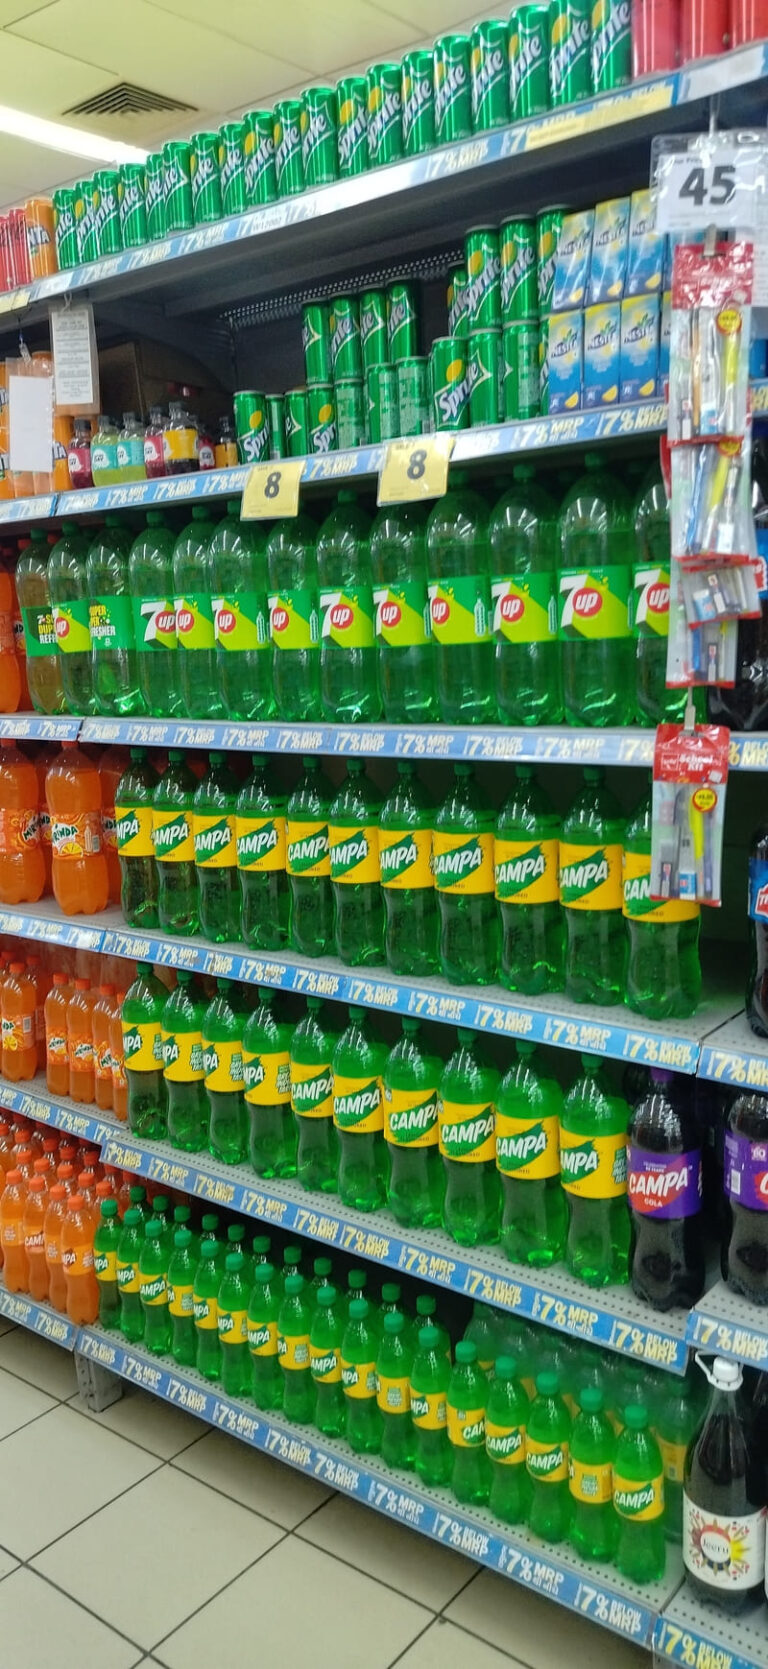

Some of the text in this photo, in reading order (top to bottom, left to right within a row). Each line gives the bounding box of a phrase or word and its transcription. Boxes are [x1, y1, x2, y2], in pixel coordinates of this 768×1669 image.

[679, 165, 736, 206] 45
[28, 225, 50, 247] NTA
[520, 418, 583, 445] 7% MRP
[602, 409, 635, 435] 7%
[407, 449, 427, 479] 8
[264, 471, 282, 498] 8
[281, 731, 300, 749] 7%
[339, 733, 360, 752] 7%
[402, 733, 454, 754] 7% MRP
[469, 735, 522, 756] 7% MRP
[545, 737, 605, 757] 7% MRP
[52, 824, 79, 844] RINDA
[117, 818, 139, 840] MPA
[152, 822, 189, 846] AMPA
[194, 826, 231, 852] AMPA
[330, 839, 369, 865] AMPA
[380, 843, 417, 870] AMPA
[245, 959, 264, 979] 7%
[296, 969, 340, 995] 7% MRP
[353, 980, 398, 1006] 7% MRP
[415, 993, 466, 1015] 7% MRP
[479, 1005, 505, 1029] 7%
[504, 1017, 533, 1035] MRP
[552, 1019, 579, 1045] 7%
[580, 1024, 612, 1042] MRP
[123, 1033, 142, 1055] MPA
[630, 1034, 659, 1061] 7%
[658, 1047, 692, 1067] MRP
[714, 1052, 747, 1083] 7%
[334, 1087, 381, 1115] CAMPA
[442, 1114, 495, 1144] CAMPA
[197, 1175, 217, 1198] 7%
[629, 1167, 688, 1198] CAMPA
[246, 1192, 288, 1216] 7% MRP
[644, 1197, 663, 1208] COLA
[297, 1210, 319, 1235] 7%
[344, 1226, 366, 1251] 7%
[364, 1242, 390, 1260] MRP
[117, 1268, 135, 1281] MPA
[405, 1248, 457, 1275] 7% MRP
[140, 1280, 165, 1296] AMPA
[469, 1270, 496, 1298] 7%
[493, 1289, 522, 1309] MRP
[540, 1294, 599, 1327] 7% MRP
[615, 1320, 646, 1356] 7%
[644, 1343, 678, 1365] MRP
[701, 1317, 768, 1362] 7% MRP
[310, 1355, 337, 1371] AMPA
[170, 1379, 188, 1403] 7%
[217, 1404, 260, 1431] 7% MRP
[463, 1421, 485, 1440] CAM
[269, 1429, 289, 1457] 7%
[314, 1454, 336, 1480] 7%
[332, 1472, 359, 1492] MRP
[374, 1483, 425, 1516] 7% MRP
[437, 1515, 462, 1546] 7%
[460, 1537, 489, 1558] MRP
[507, 1548, 534, 1582] 7%
[533, 1561, 565, 1586] MRP
[580, 1585, 609, 1621] 7%
[608, 1610, 641, 1636] MRP
[665, 1623, 698, 1666] 7%
